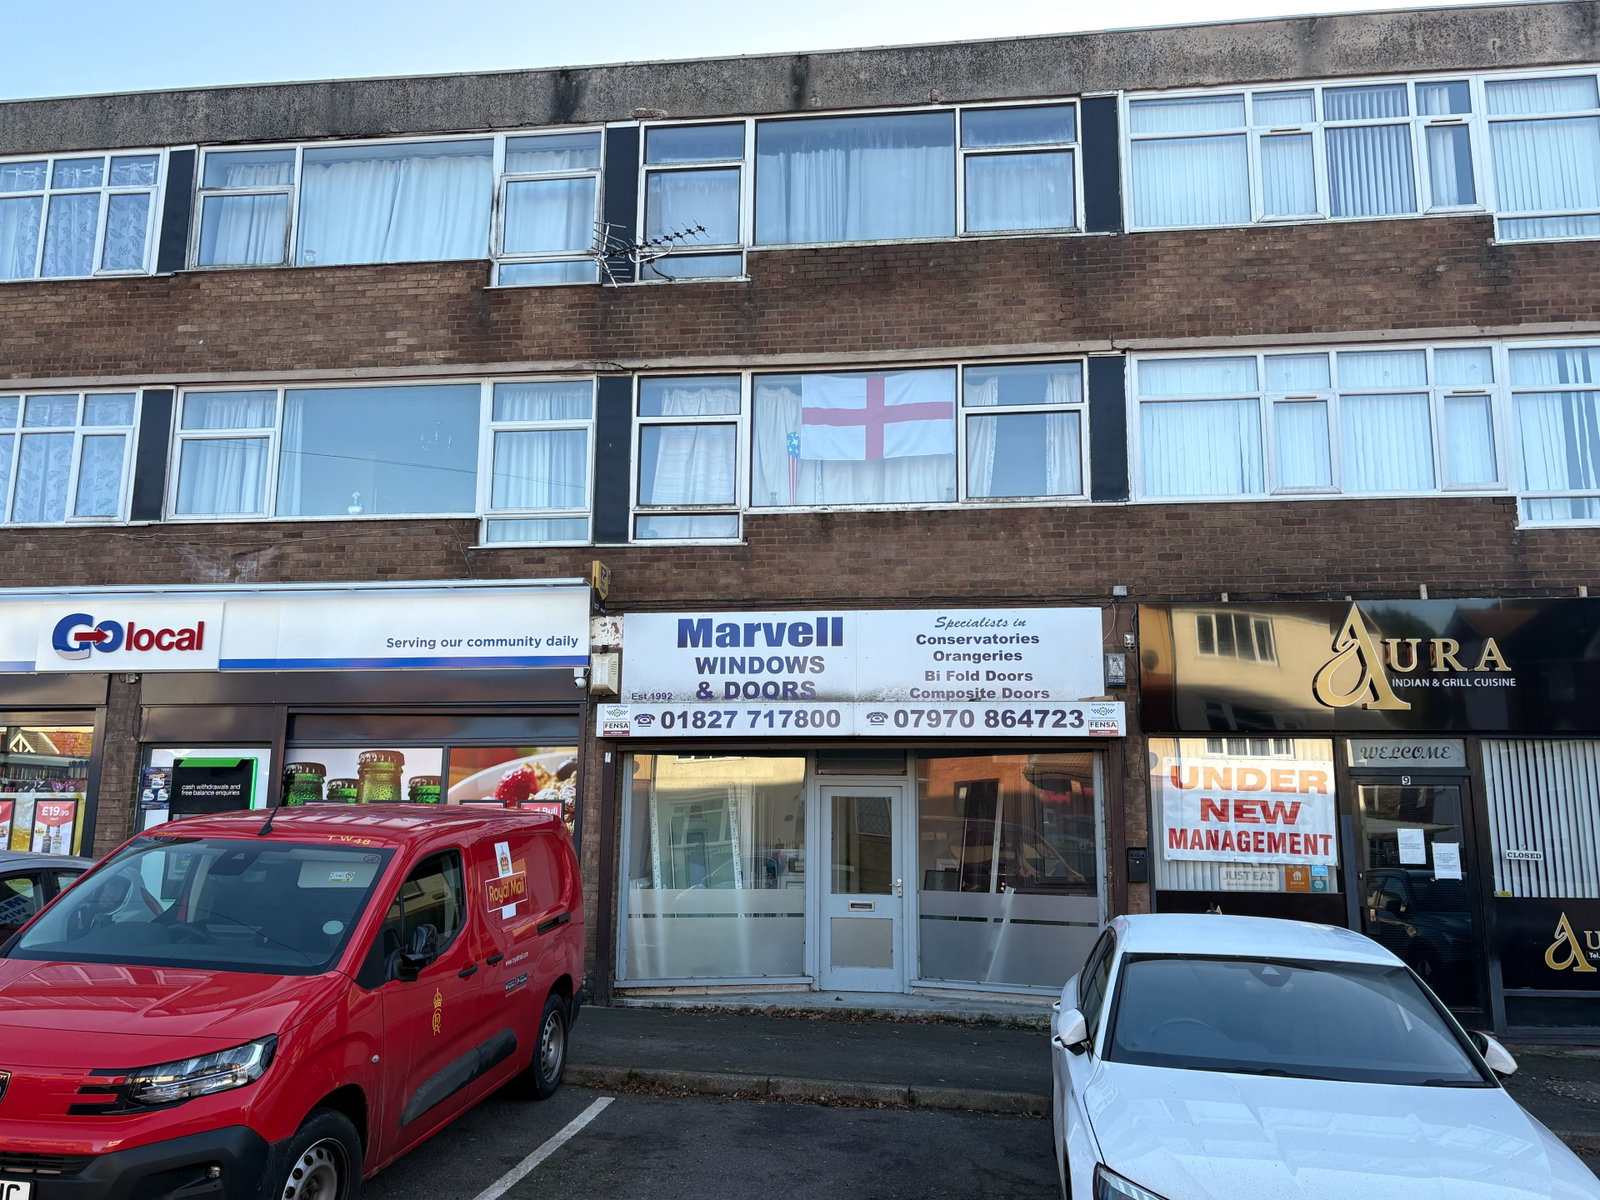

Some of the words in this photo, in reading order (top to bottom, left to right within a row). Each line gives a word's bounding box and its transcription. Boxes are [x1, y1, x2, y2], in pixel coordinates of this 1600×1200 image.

[934, 616, 1009, 630] Specialists
[1013, 616, 1027, 627] in
[125, 621, 205, 651] local
[677, 616, 844, 649] Marvell
[916, 633, 1040, 645] Conservatories
[386, 636, 437, 650] Serving
[441, 638, 463, 648] our
[467, 636, 541, 650] community
[546, 635, 579, 649] daily
[933, 650, 1023, 664] Orangeries
[1312, 602, 1512, 711] AURA
[695, 656, 825, 675] WINDOWS
[924, 670, 941, 682] Bi
[946, 670, 980, 682] Fold
[985, 670, 1033, 682] Doors
[1392, 678, 1428, 688] INDIAN
[1432, 678, 1440, 688] &
[1442, 678, 1471, 688] GRILL
[1474, 677, 1517, 688] CUISINE
[650, 692, 673, 701] 1992
[696, 681, 714, 700] &
[724, 681, 817, 700] DOORS
[909, 687, 996, 701] Composite
[1002, 687, 1050, 699] Doors
[660, 710, 738, 729] 01827
[747, 709, 841, 729] 717800
[893, 709, 975, 729] 07970
[984, 709, 1085, 729] 864723
[1360, 745, 1451, 760] WELCOME
[1170, 765, 1329, 795] UNDER
[1403, 776, 1410, 785] 9
[1200, 798, 1302, 825] NEW
[1168, 828, 1333, 857] MANAGEMENT
[1507, 851, 1542, 859] CLOSED
[1223, 871, 1251, 881] JUST
[1253, 871, 1275, 882] EAT
[488, 881, 509, 904] Royal
[510, 877, 525, 896] Mail
